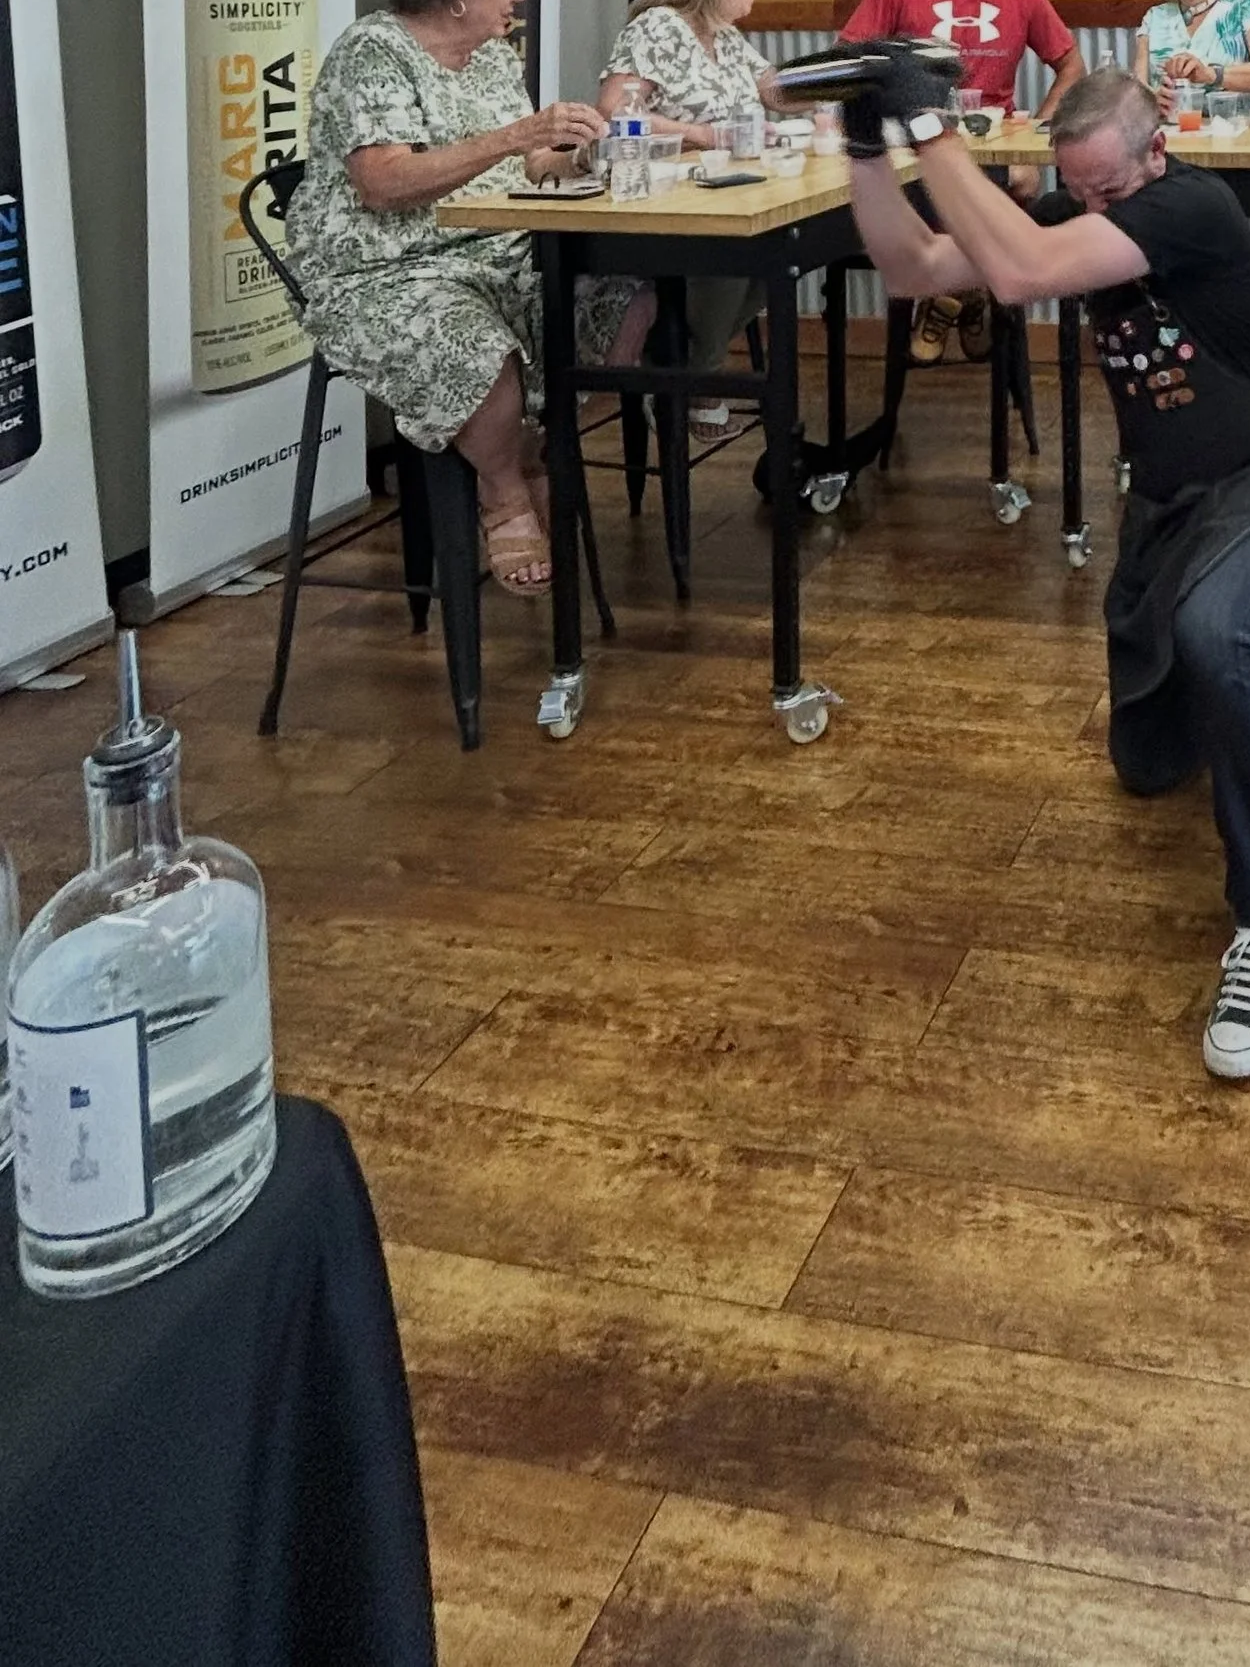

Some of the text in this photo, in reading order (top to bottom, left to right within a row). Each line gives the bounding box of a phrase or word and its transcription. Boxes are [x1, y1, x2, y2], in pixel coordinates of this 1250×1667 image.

[208, 1, 302, 20] SIMPLICITY
[237, 253, 266, 268] READ
[238, 264, 278, 286] DRIN
